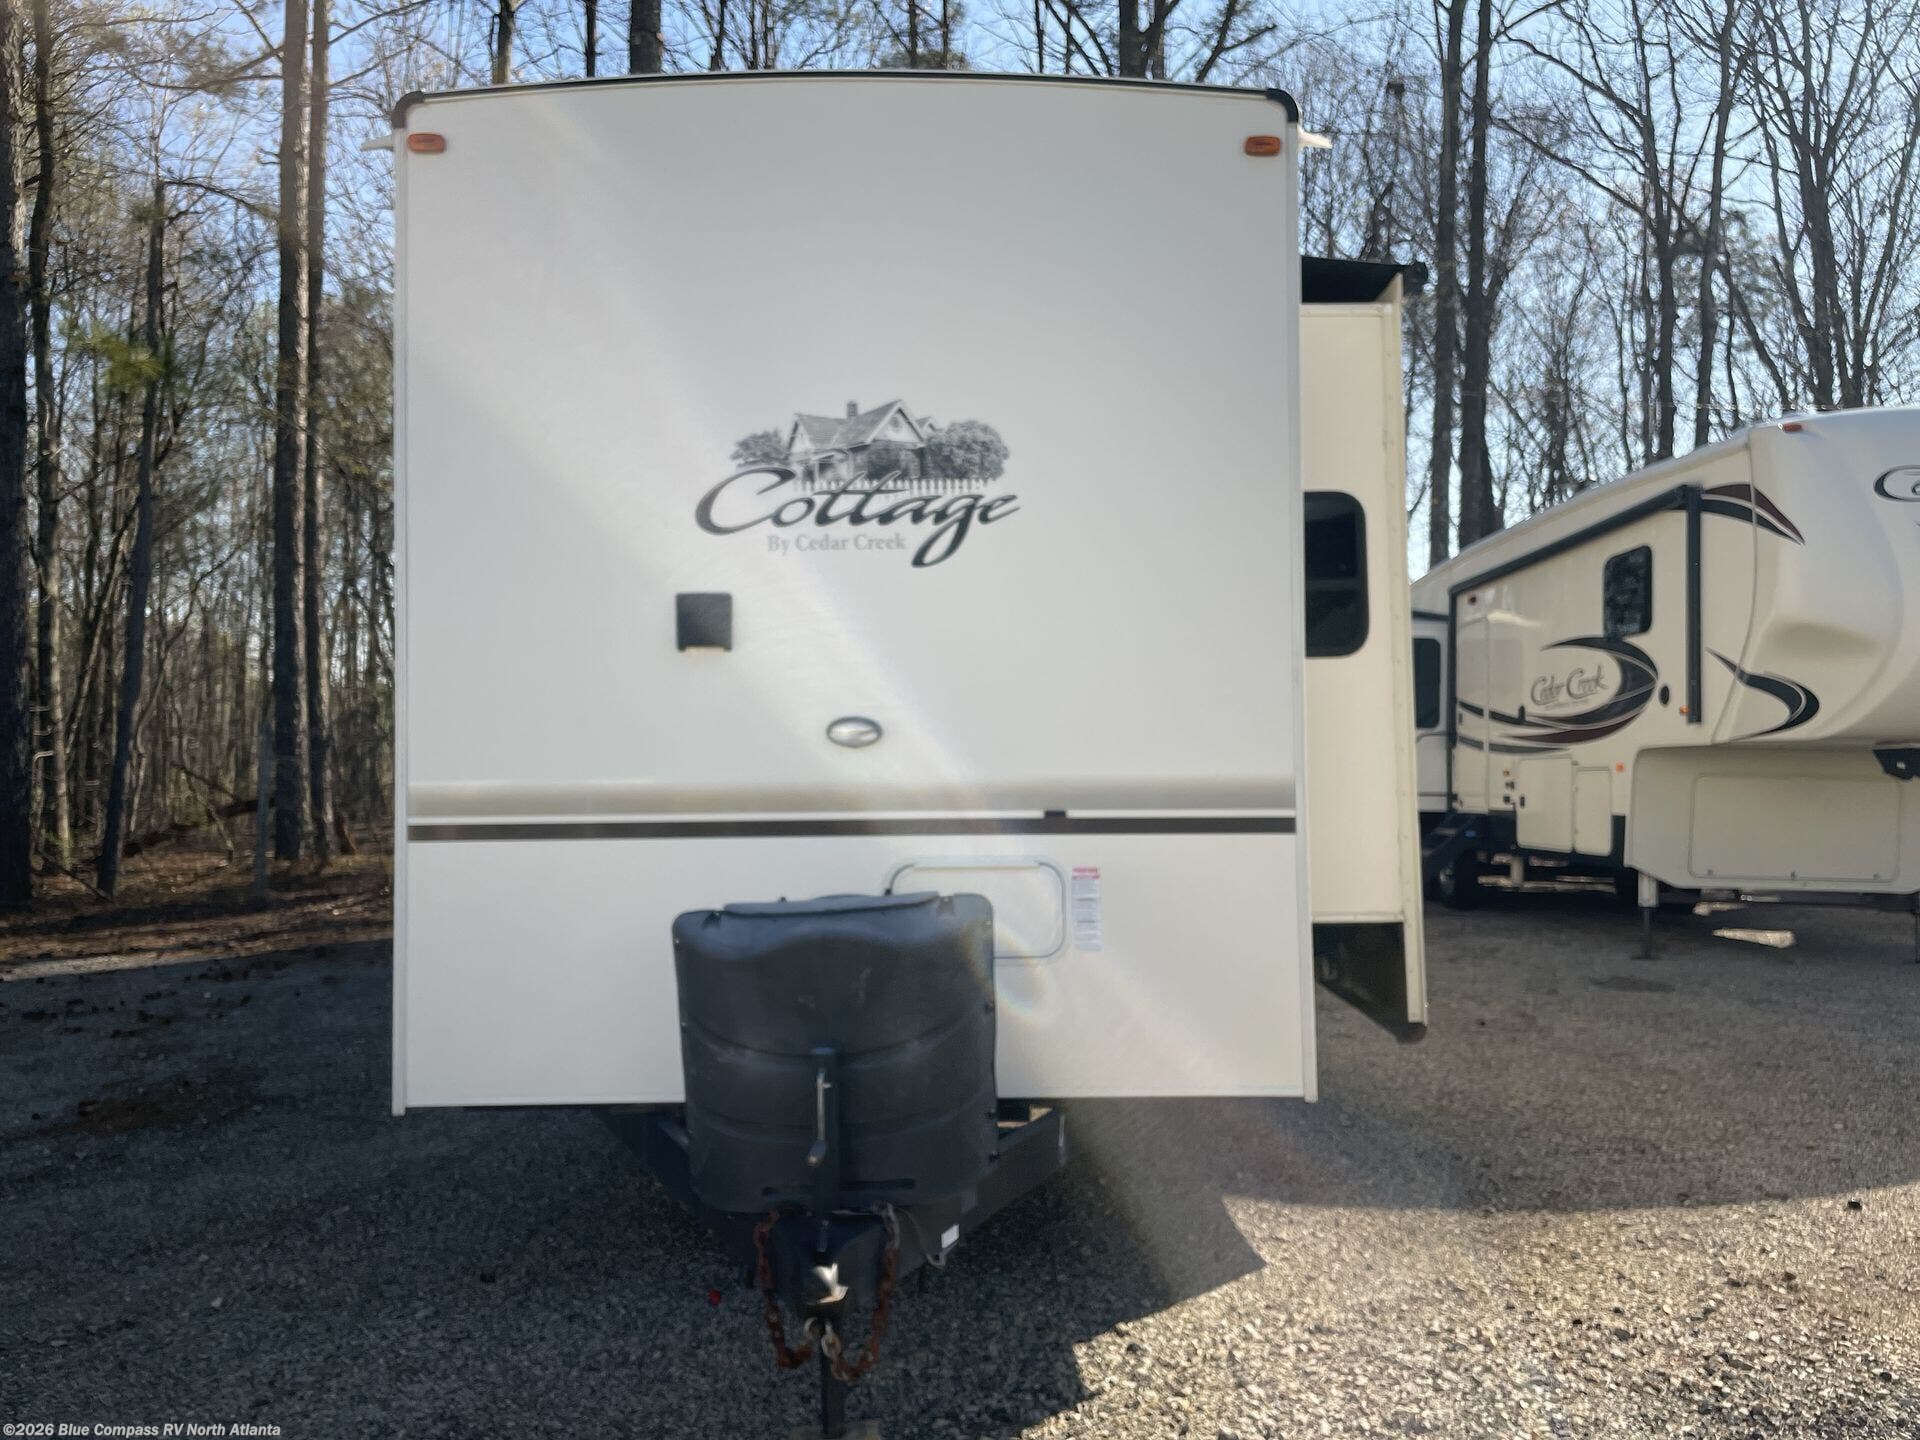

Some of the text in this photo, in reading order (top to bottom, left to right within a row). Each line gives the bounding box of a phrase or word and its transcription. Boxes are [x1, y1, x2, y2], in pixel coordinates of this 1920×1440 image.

[695, 466, 1020, 568] Cottage
[767, 532, 906, 556] By Cedar Creek
